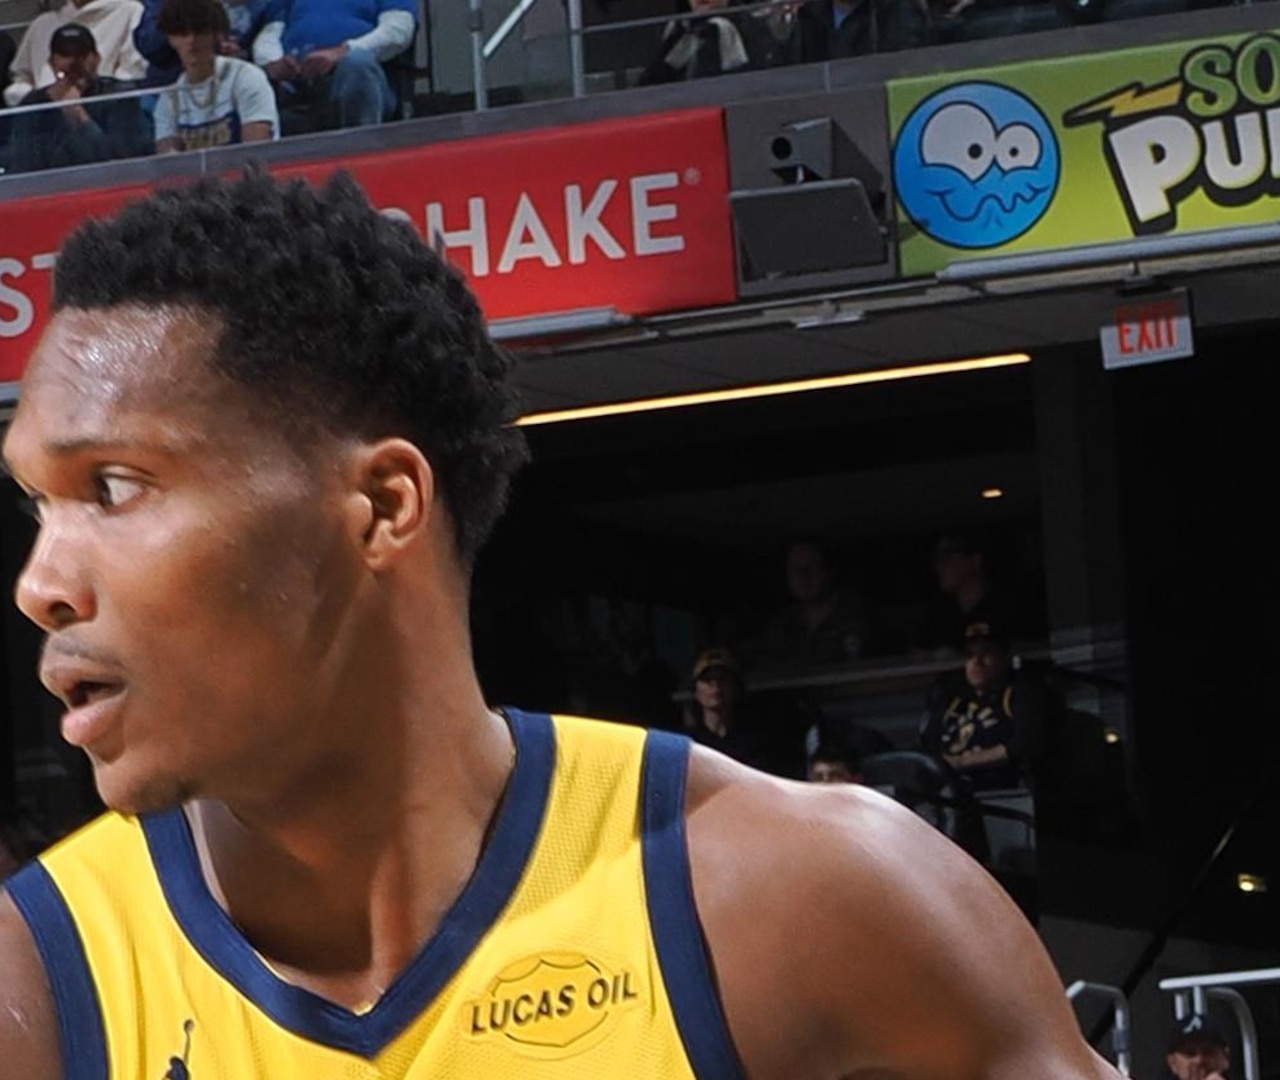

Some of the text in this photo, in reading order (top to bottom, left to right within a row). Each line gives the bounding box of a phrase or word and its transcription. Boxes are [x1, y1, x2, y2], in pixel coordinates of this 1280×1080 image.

[379, 172, 685, 277] HAKE
[1115, 300, 1175, 354] EXIT
[471, 972, 638, 1035] LUCAS OIL
